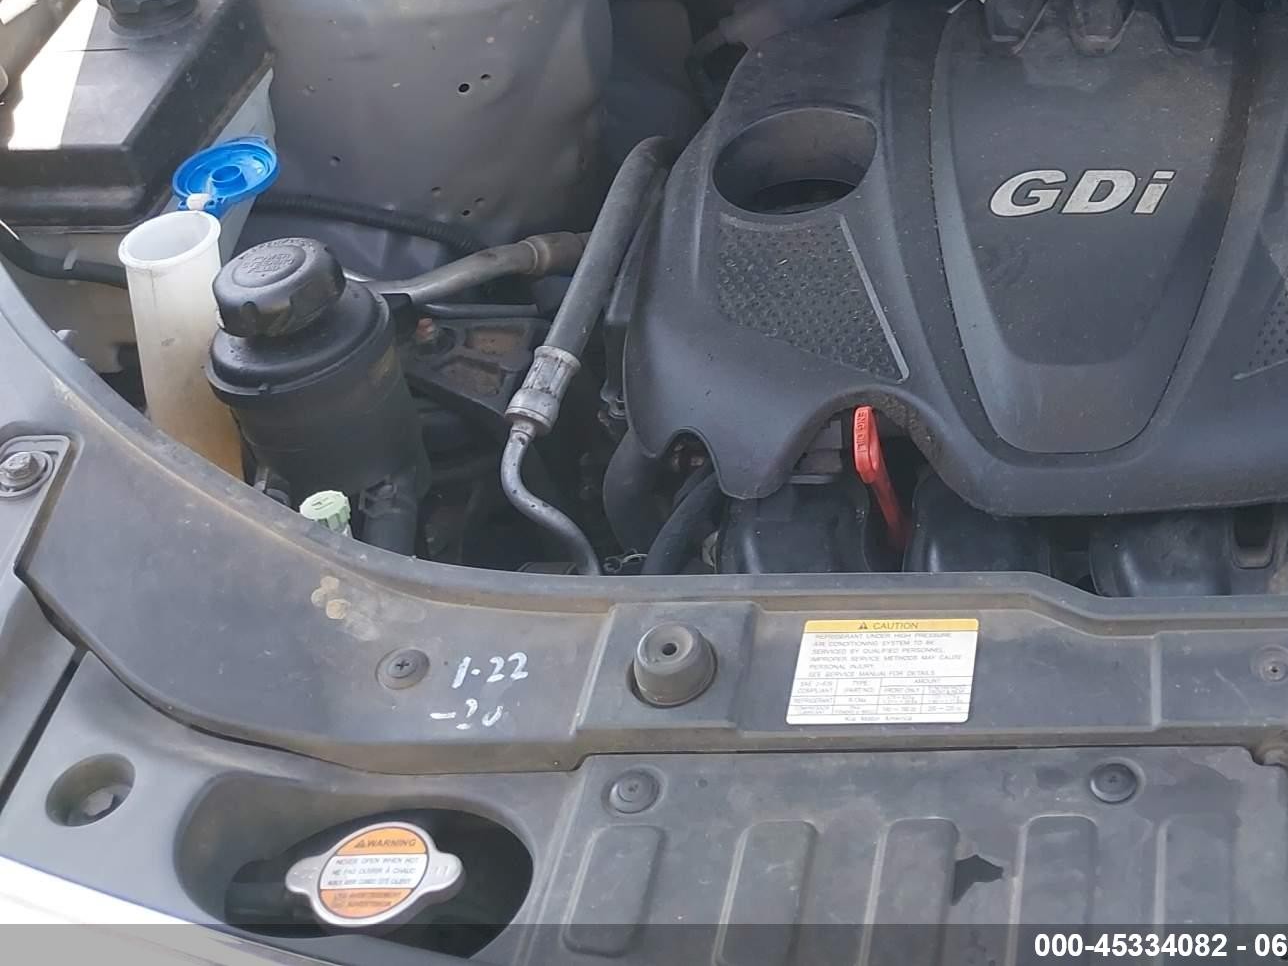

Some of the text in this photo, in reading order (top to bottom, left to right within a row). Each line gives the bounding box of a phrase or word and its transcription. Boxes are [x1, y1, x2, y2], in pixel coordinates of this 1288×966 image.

[990, 169, 1176, 216] GDi
[872, 621, 919, 630] CAUTION
[367, 838, 417, 847] WARNING
